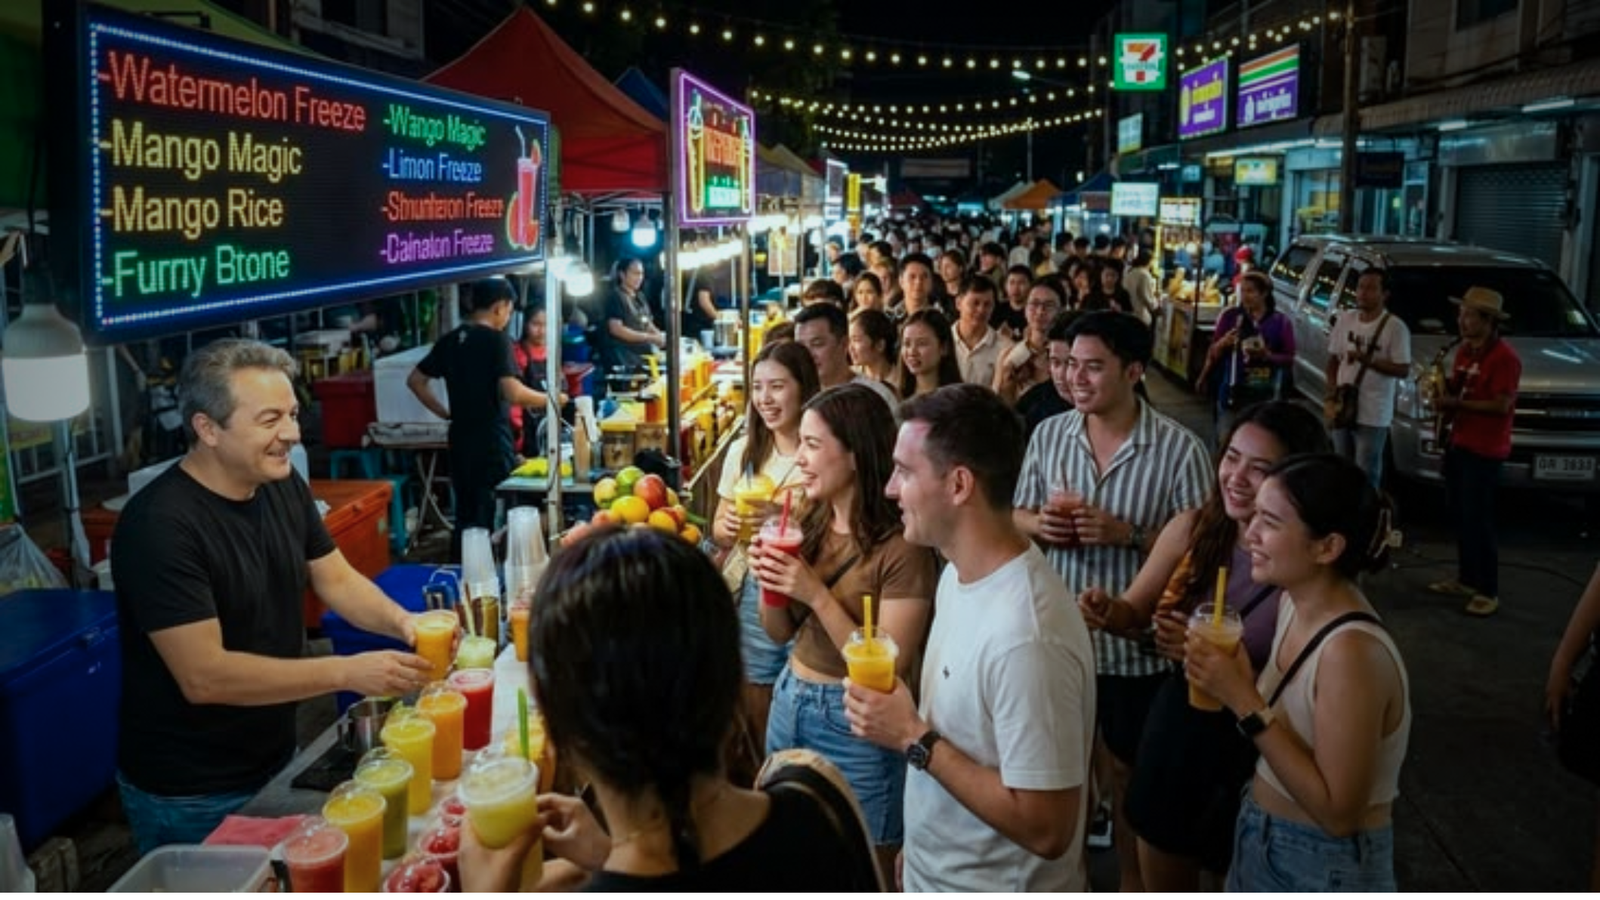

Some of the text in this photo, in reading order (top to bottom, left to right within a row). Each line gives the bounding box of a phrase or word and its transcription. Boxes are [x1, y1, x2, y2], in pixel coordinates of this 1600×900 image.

[294, 86, 367, 132] Freeze
[447, 114, 487, 151] Magic
[227, 131, 303, 183] Magic
[437, 152, 483, 182] Freeze
[227, 188, 284, 228] Rice
[216, 245, 290, 284] Btone
